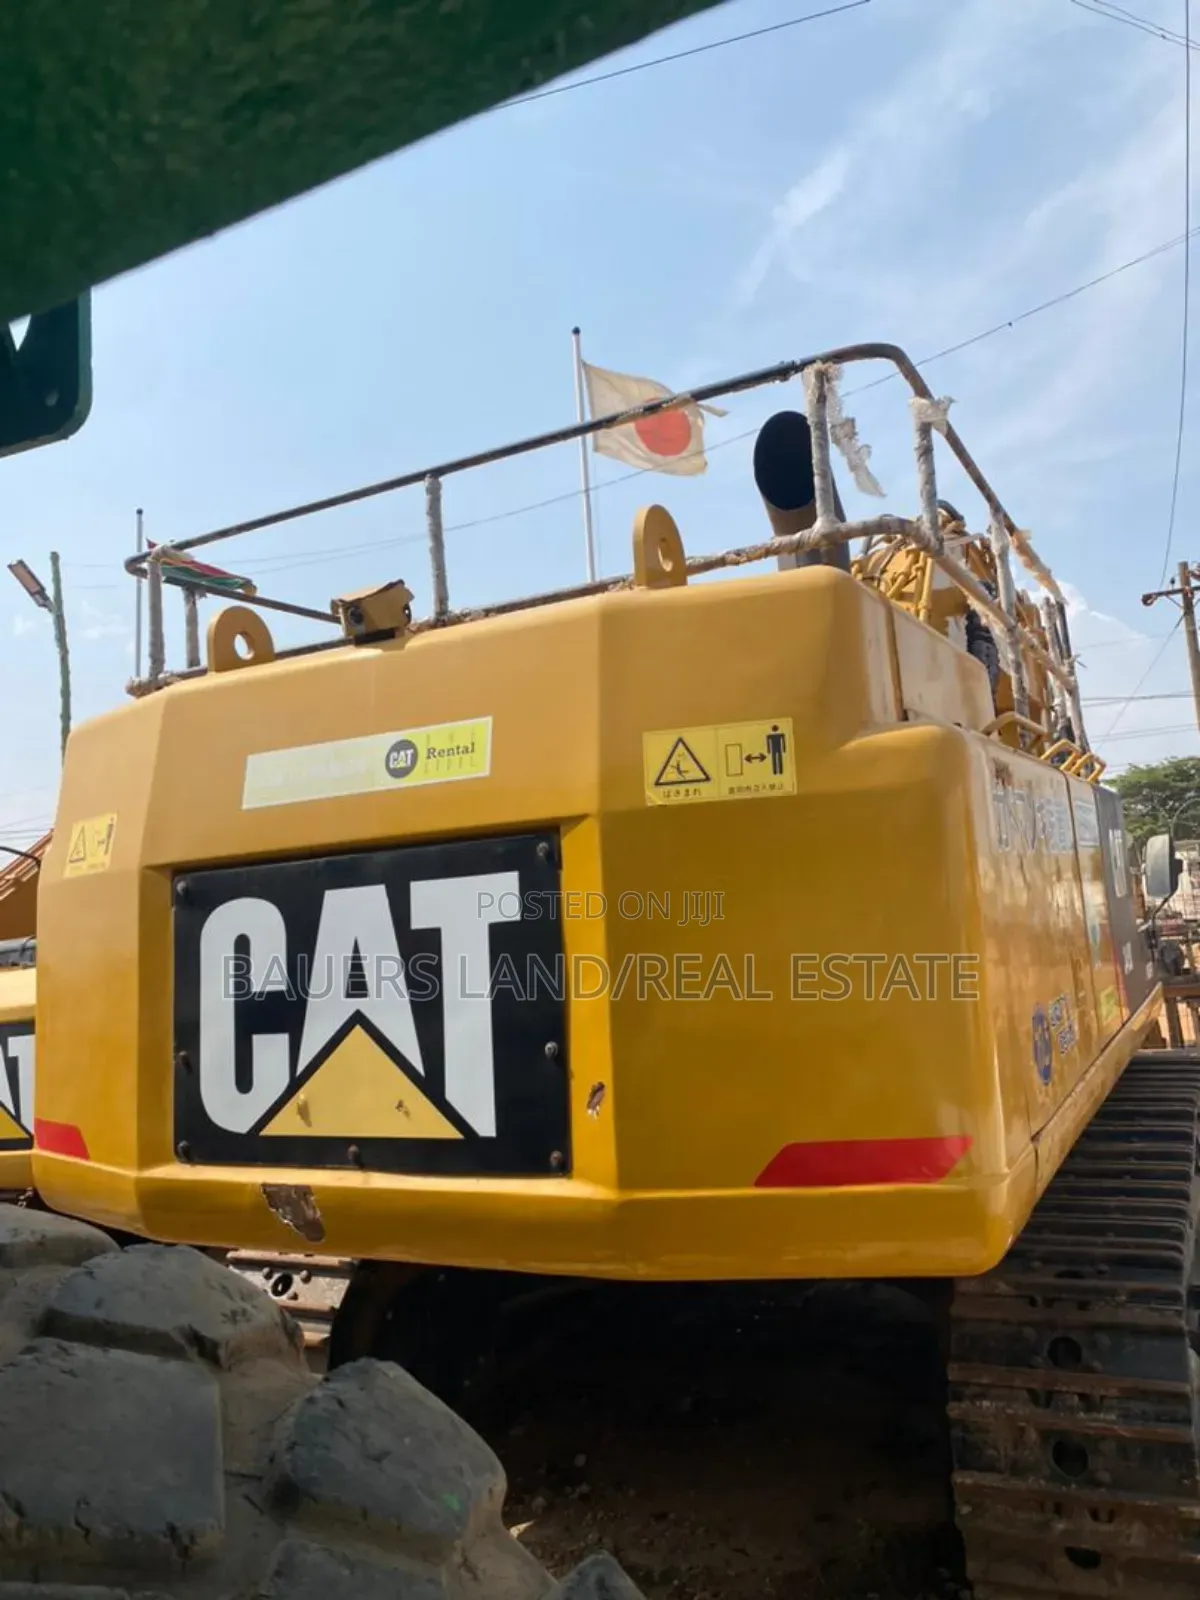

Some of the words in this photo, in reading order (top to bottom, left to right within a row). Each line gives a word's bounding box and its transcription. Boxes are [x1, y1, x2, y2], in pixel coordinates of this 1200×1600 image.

[389, 748, 414, 770] CAT
[426, 741, 475, 760] Rental
[200, 871, 520, 1138] CAT
